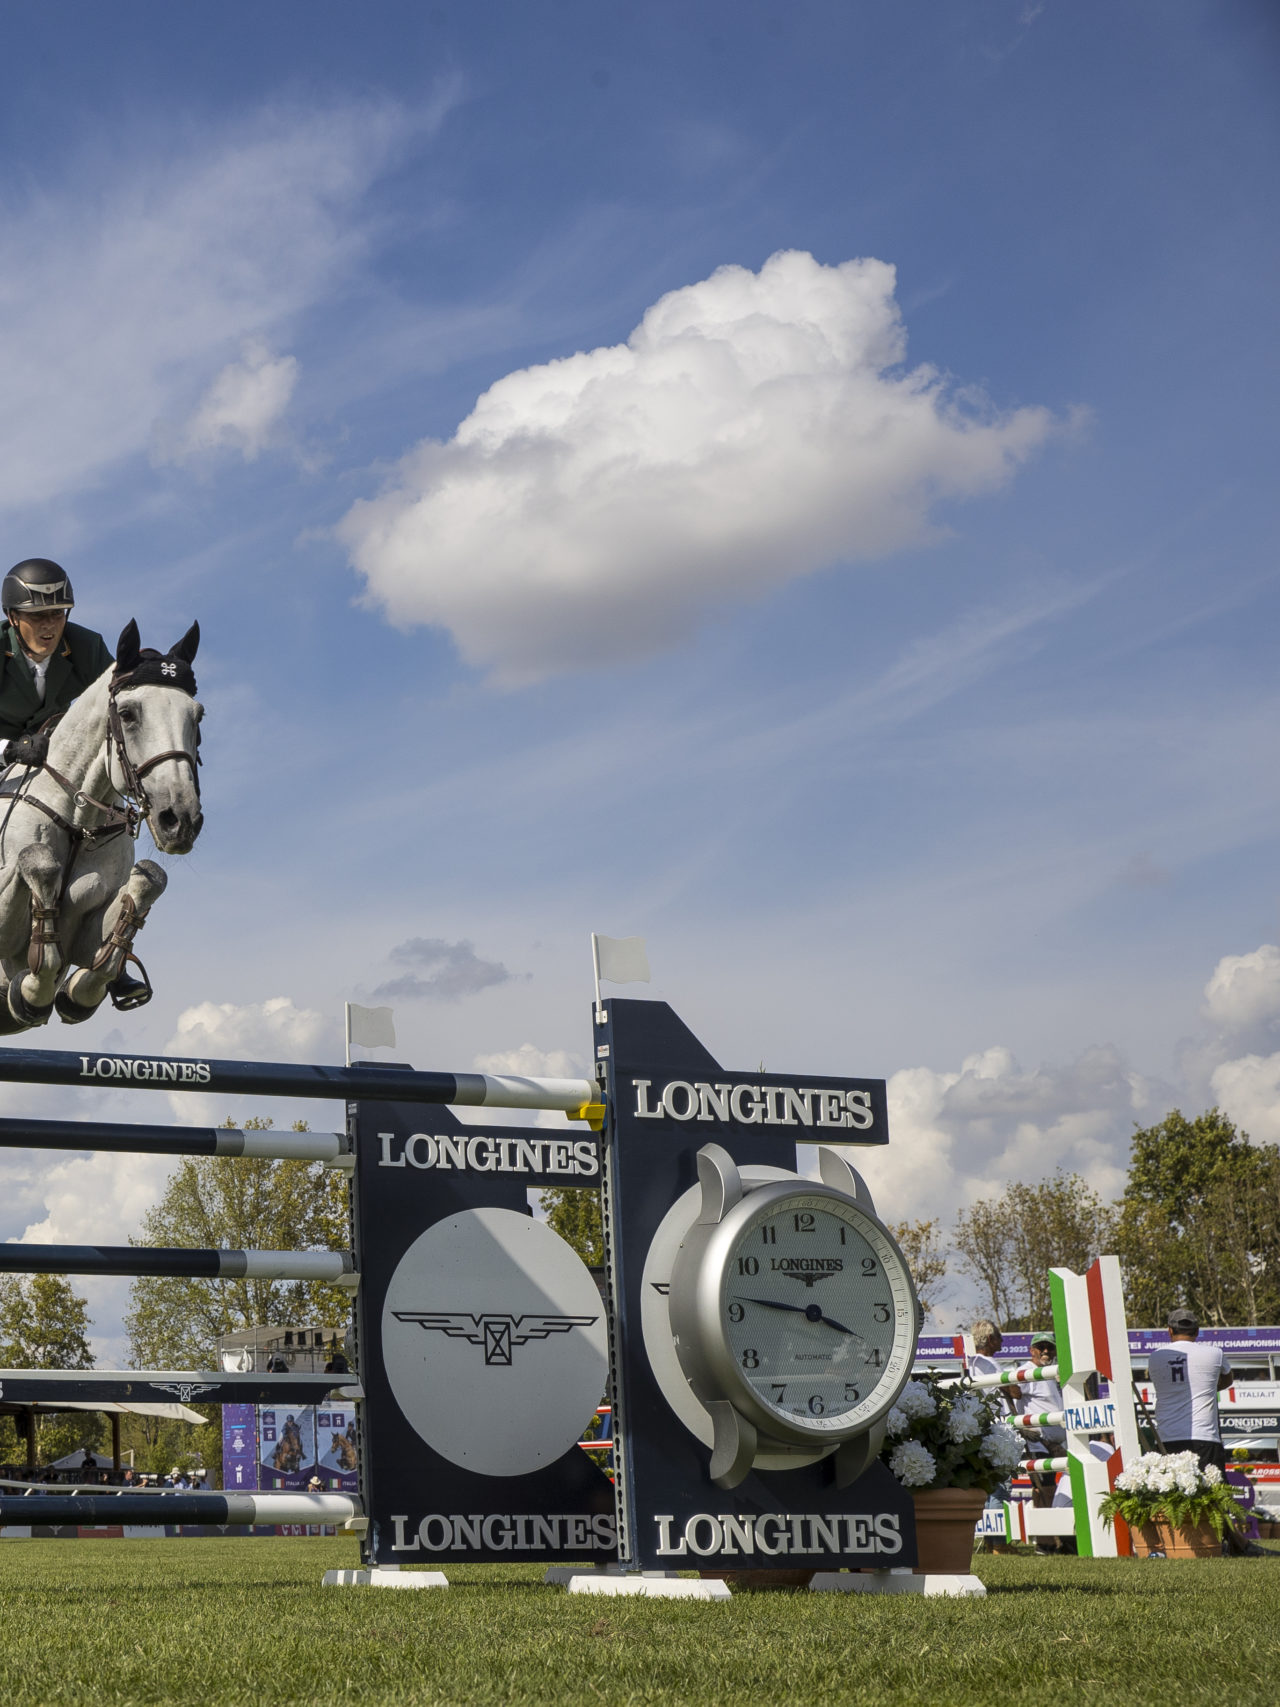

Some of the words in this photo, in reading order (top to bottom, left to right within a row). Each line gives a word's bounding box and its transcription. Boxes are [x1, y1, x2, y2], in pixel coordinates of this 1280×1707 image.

[79, 1056, 211, 1083] LONGINES
[631, 1079, 874, 1129] LONGINES
[377, 1132, 599, 1176] LONGINES
[794, 1213, 816, 1233] 12
[762, 1224, 776, 1245] 11
[840, 1226, 846, 1246] 1
[738, 1256, 760, 1277] 10
[770, 1258, 844, 1272] LONGINES
[861, 1257, 877, 1277] 2
[728, 1302, 745, 1323] 9
[873, 1303, 891, 1323] 3
[742, 1348, 760, 1369] 8
[794, 1353, 833, 1361] AUTOMATIC
[864, 1348, 883, 1368] 4
[921, 1347, 956, 1355] CHAMPIO
[771, 1383, 788, 1404] 7
[844, 1382, 860, 1402] 5
[808, 1394, 825, 1416] 6
[1064, 1404, 1116, 1430] ITALIA.IT
[1220, 1418, 1278, 1427] LONGINES
[390, 1514, 617, 1551] LONGINES
[654, 1513, 903, 1556] LONGINES
